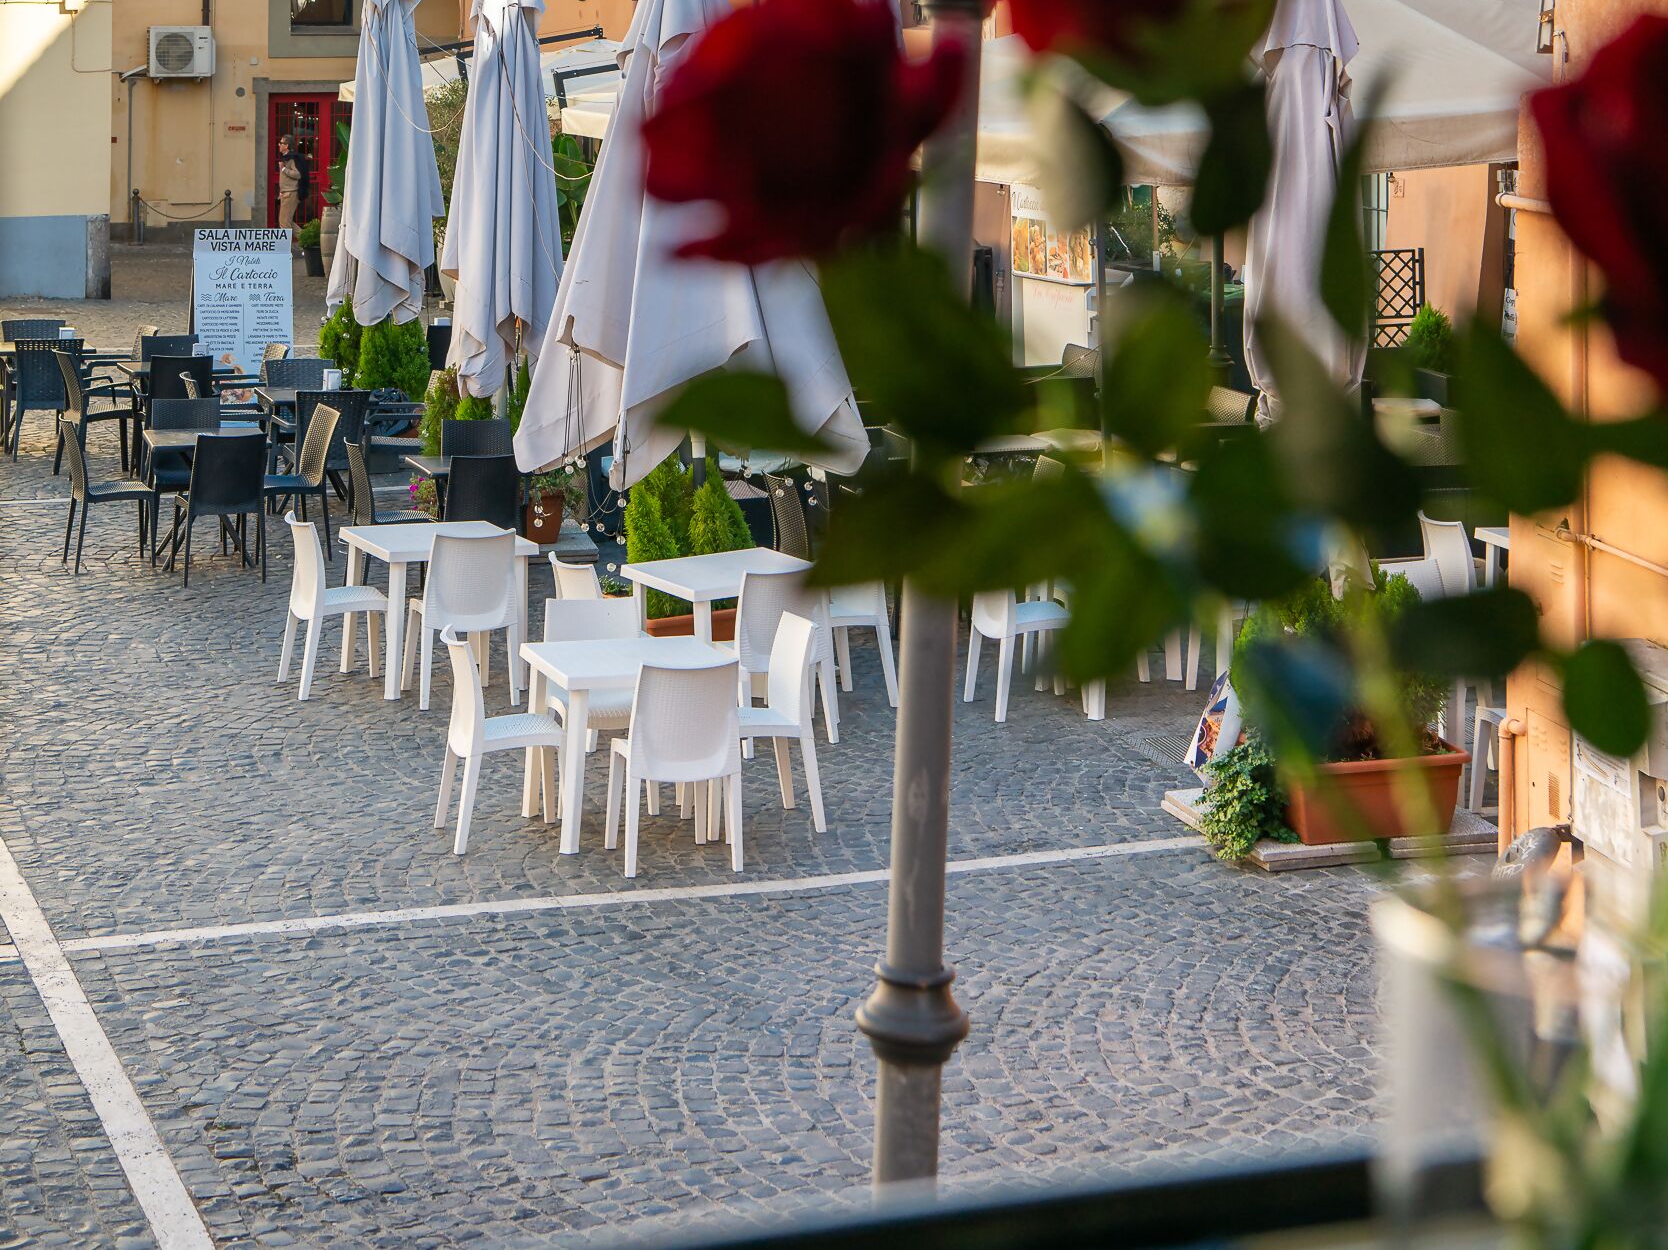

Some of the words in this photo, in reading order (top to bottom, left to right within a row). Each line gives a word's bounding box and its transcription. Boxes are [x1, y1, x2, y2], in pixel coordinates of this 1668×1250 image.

[198, 230, 230, 240] SALA
[234, 230, 288, 240] INTERNA
[211, 242, 241, 251] VISTA
[245, 241, 276, 251] MARE
[230, 268, 278, 281] Cartoccio
[214, 292, 238, 303] Mare
[263, 292, 285, 302] Terra
